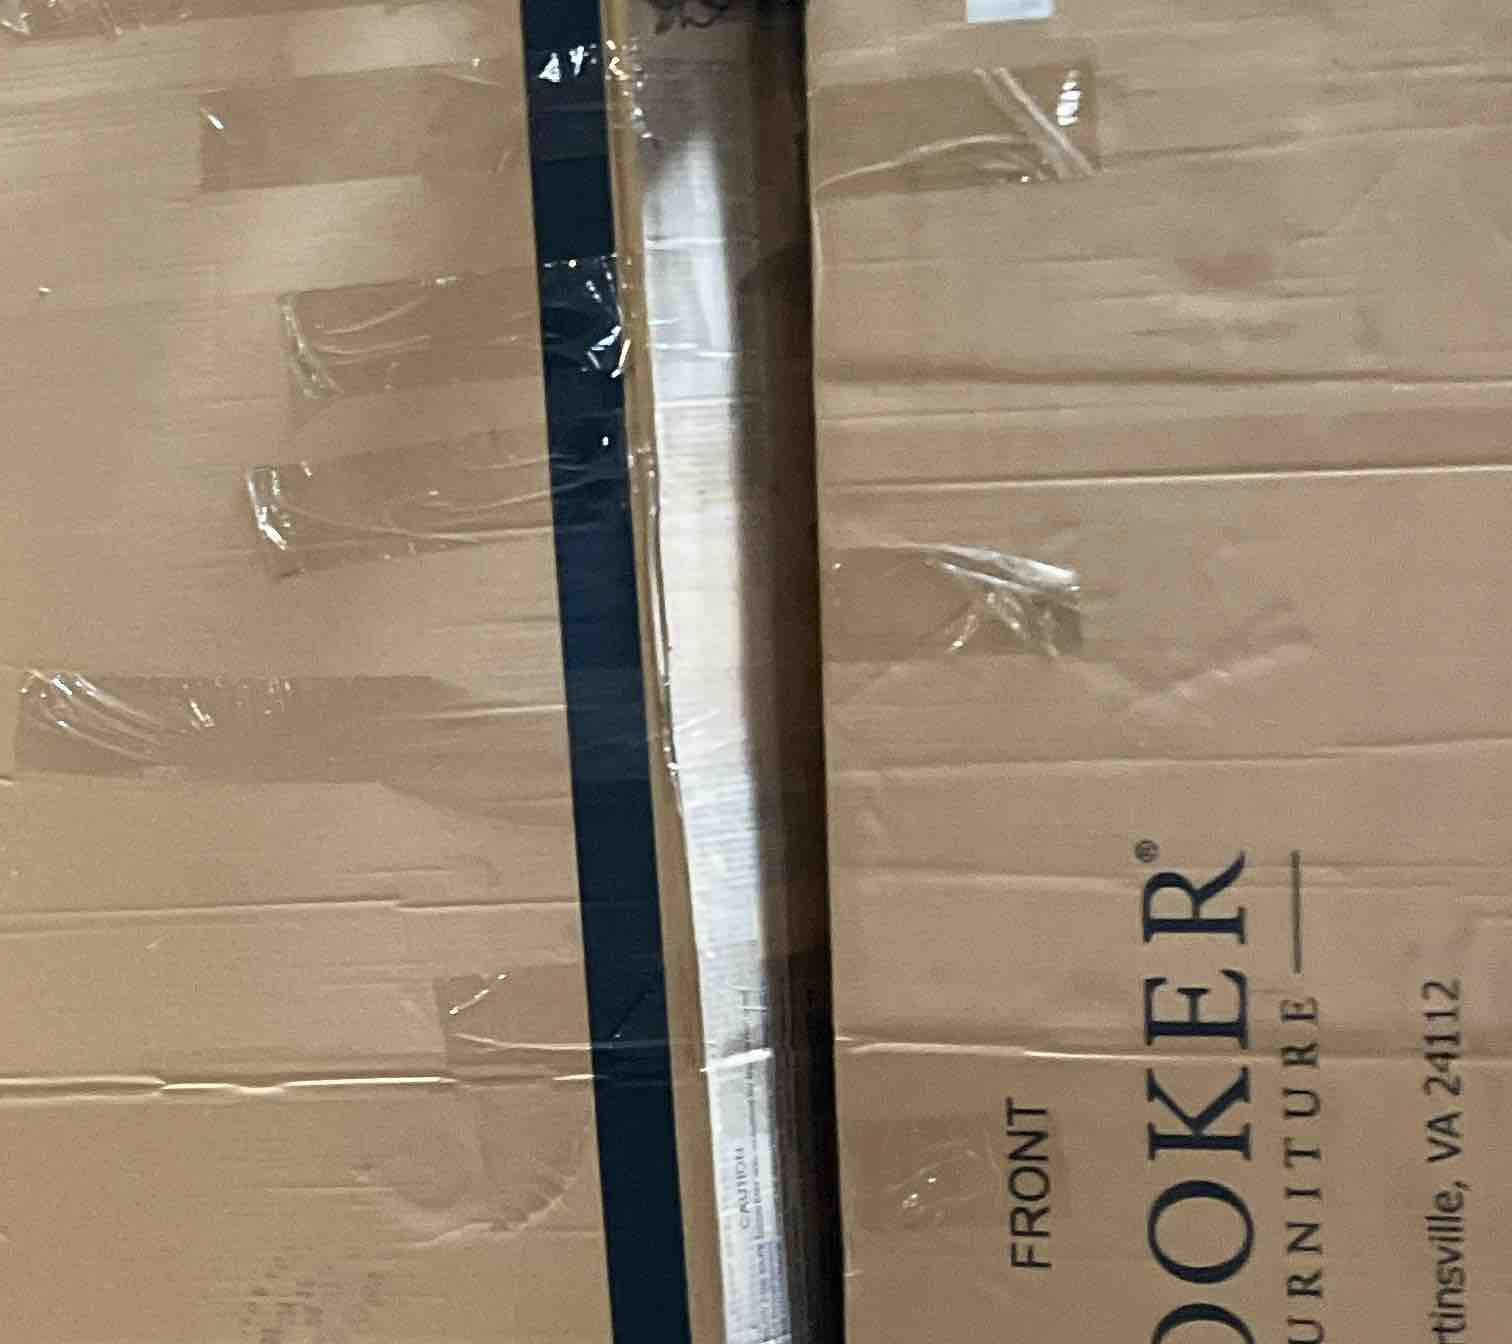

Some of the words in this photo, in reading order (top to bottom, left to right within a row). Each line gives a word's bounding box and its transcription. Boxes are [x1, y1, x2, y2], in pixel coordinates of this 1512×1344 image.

[1420, 979, 1462, 1097] 24112
[733, 1146, 751, 1231] CAUTION
[1005, 1097, 1052, 1270] FRONT
[1425, 1112, 1461, 1164] VA
